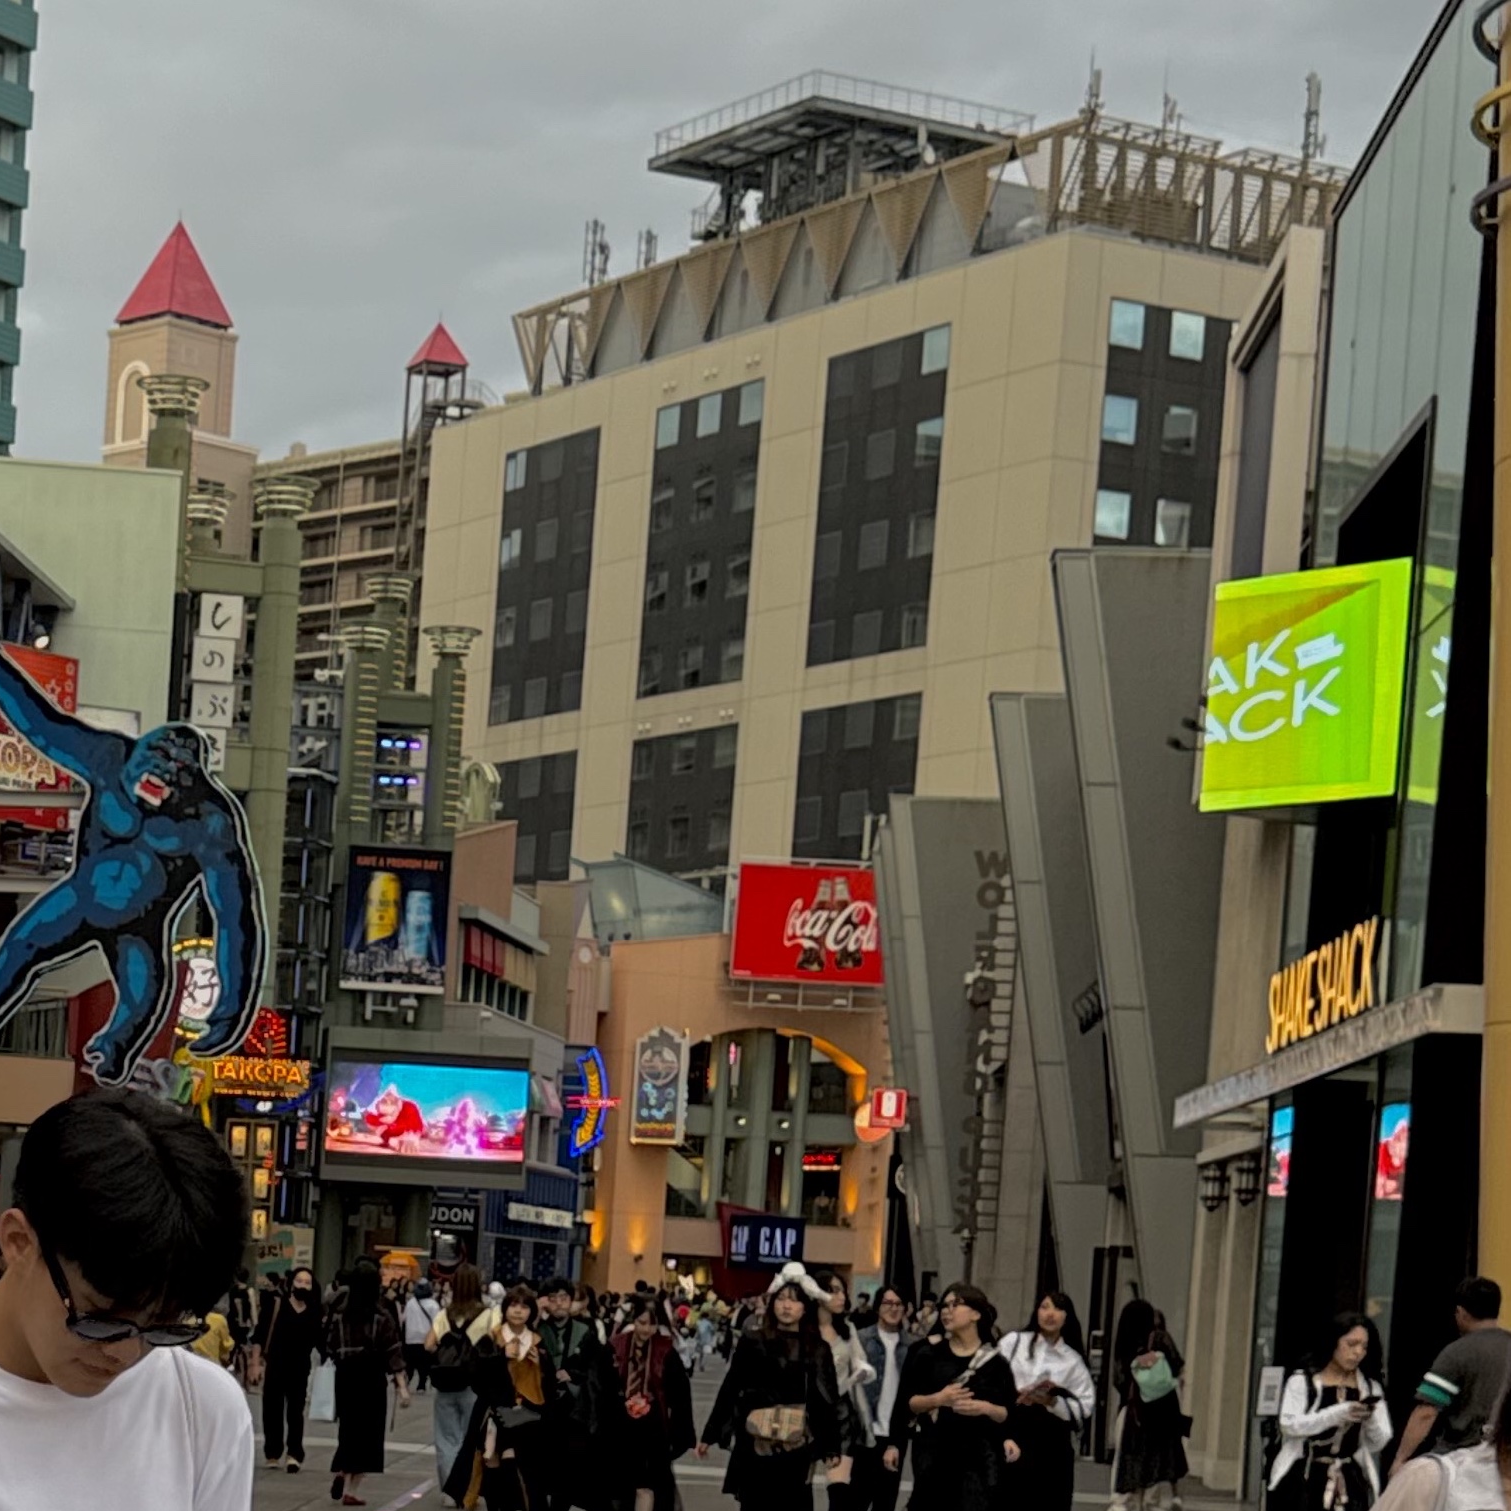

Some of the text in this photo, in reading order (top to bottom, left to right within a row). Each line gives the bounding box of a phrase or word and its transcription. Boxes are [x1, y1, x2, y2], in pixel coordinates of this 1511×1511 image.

[1265, 950, 1318, 1055] SHAKE
[1313, 914, 1379, 1032] SHACK
[213, 1060, 303, 1084] TAKOPA
[758, 1226, 797, 1257] GAP
